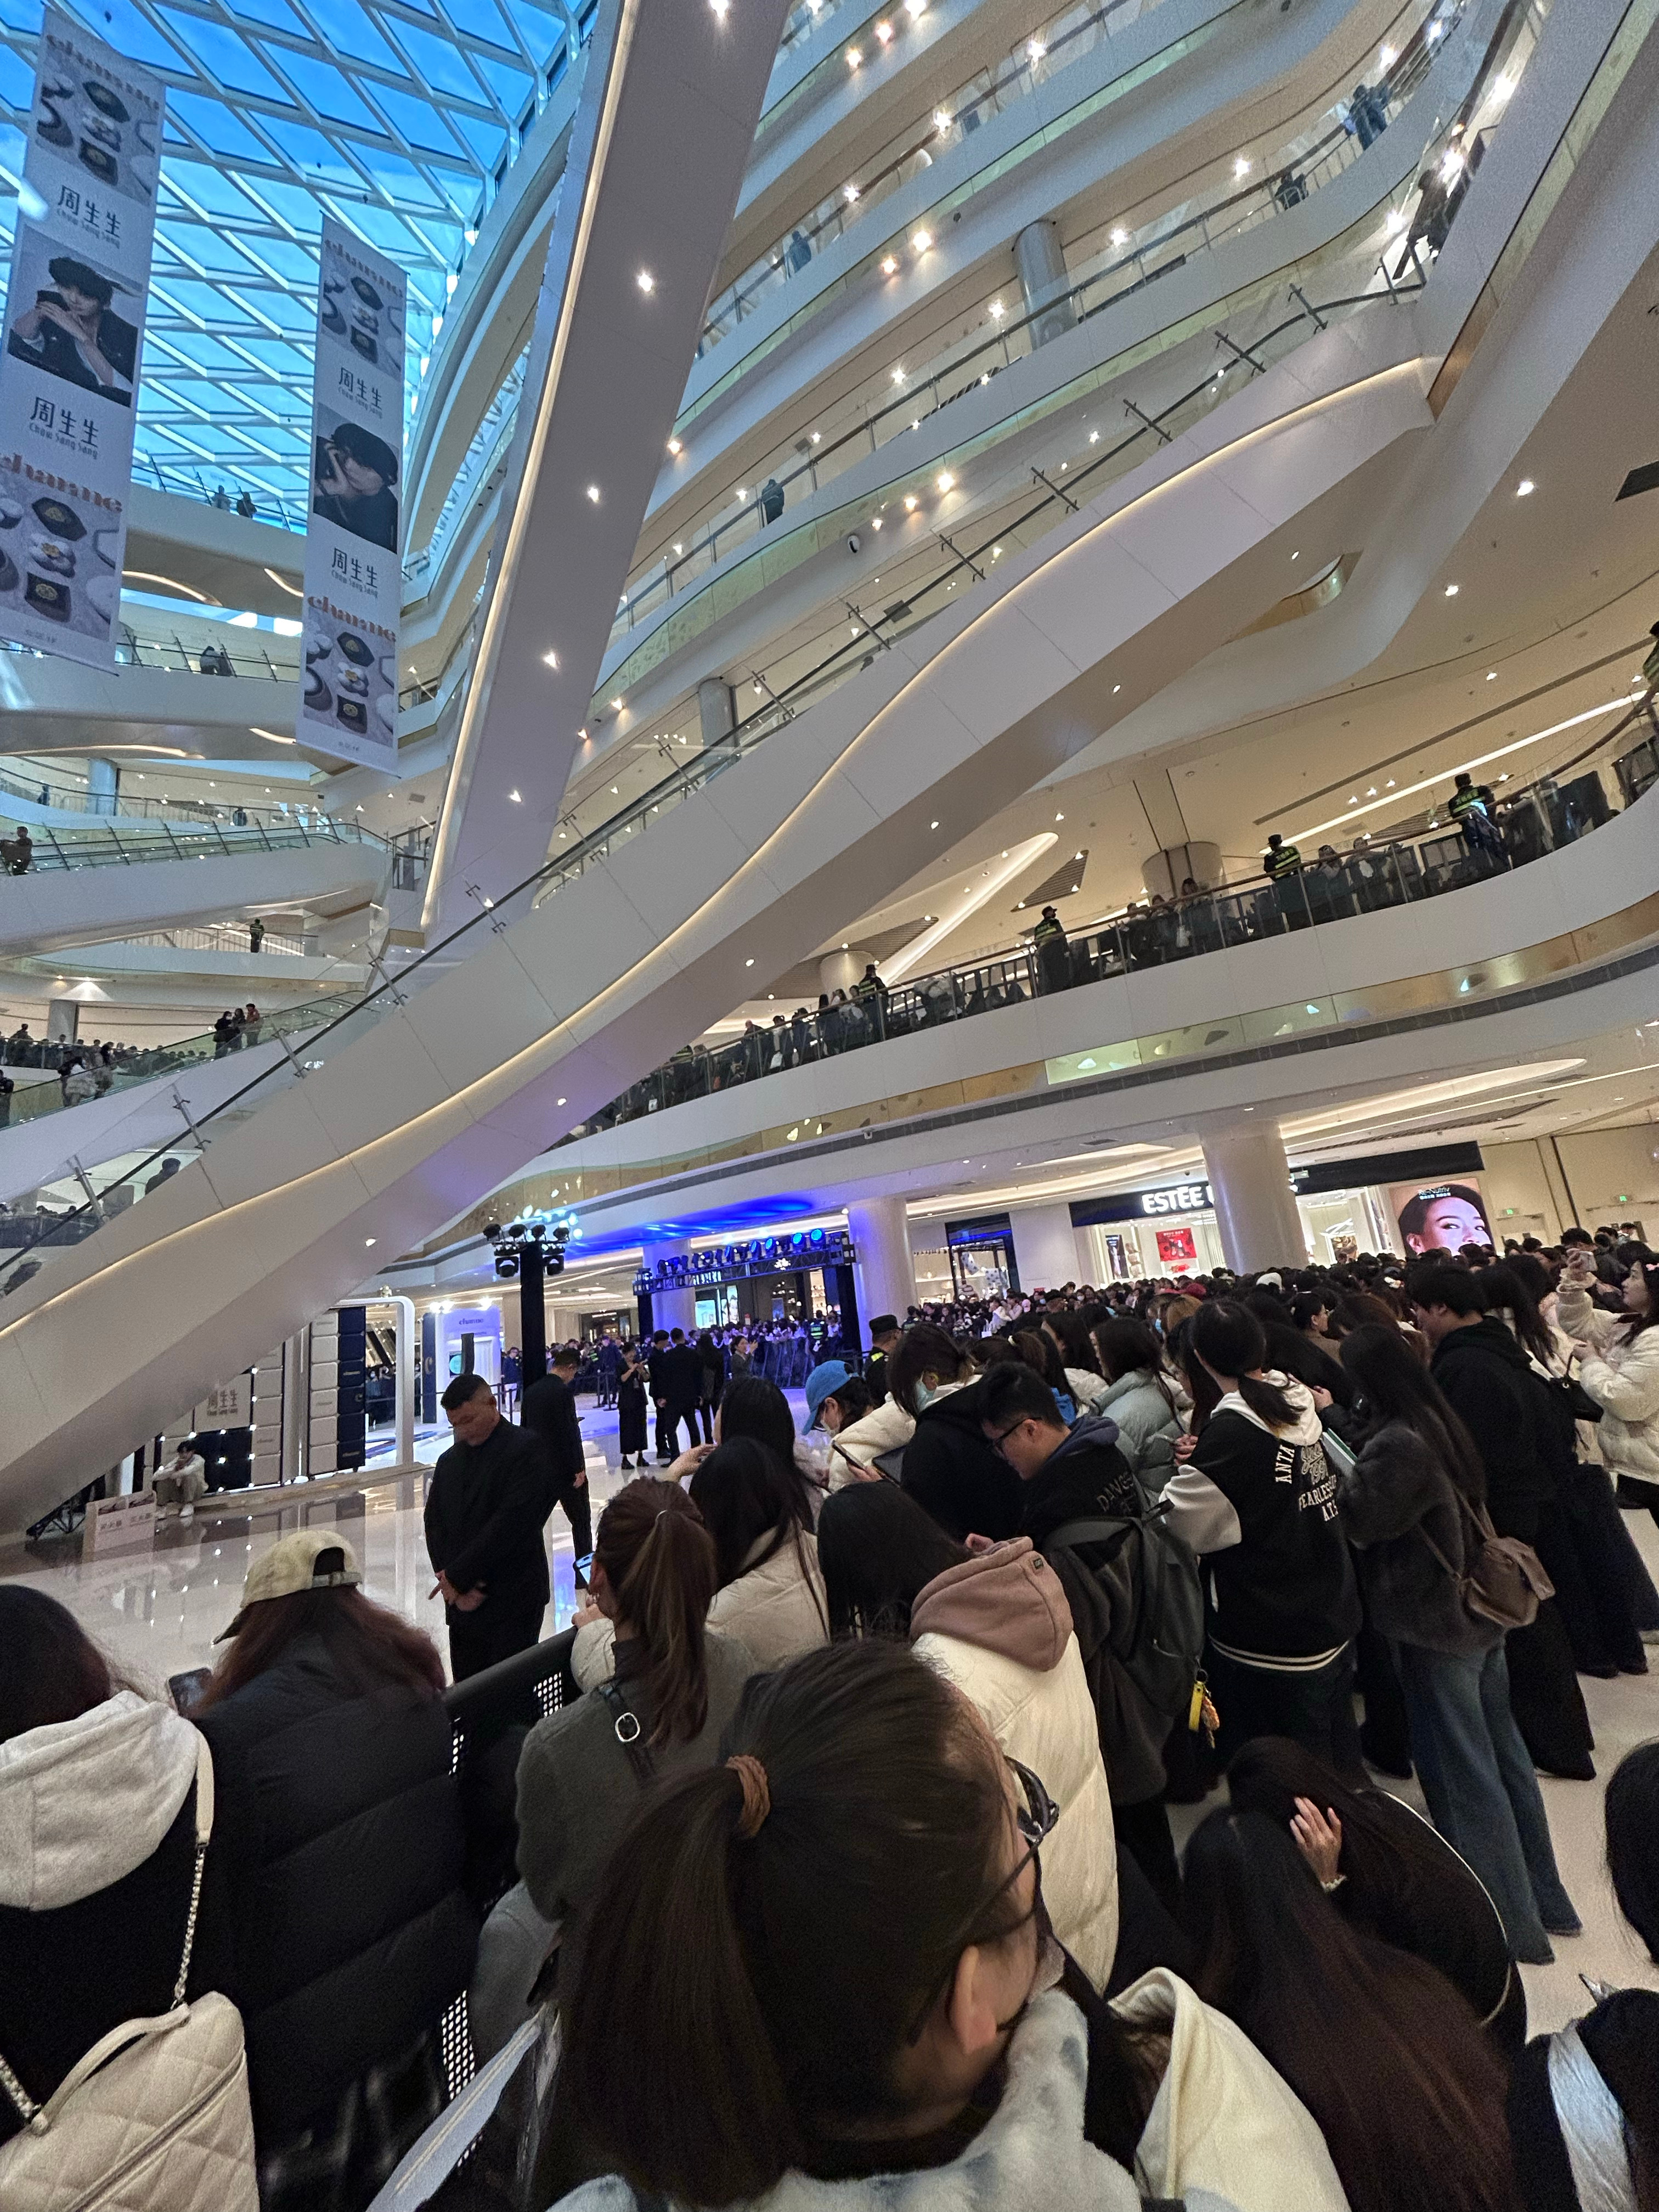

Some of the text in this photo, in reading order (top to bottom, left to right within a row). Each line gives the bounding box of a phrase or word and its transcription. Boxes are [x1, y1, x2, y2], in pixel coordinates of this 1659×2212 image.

[58, 185, 121, 238] 周生生
[339, 367, 382, 410] 周生生
[29, 422, 98, 460] Chow Sang Sang
[30, 397, 98, 448] 周生生
[332, 548, 377, 588] 周生生
[1275, 1444, 1295, 1484] ANTA
